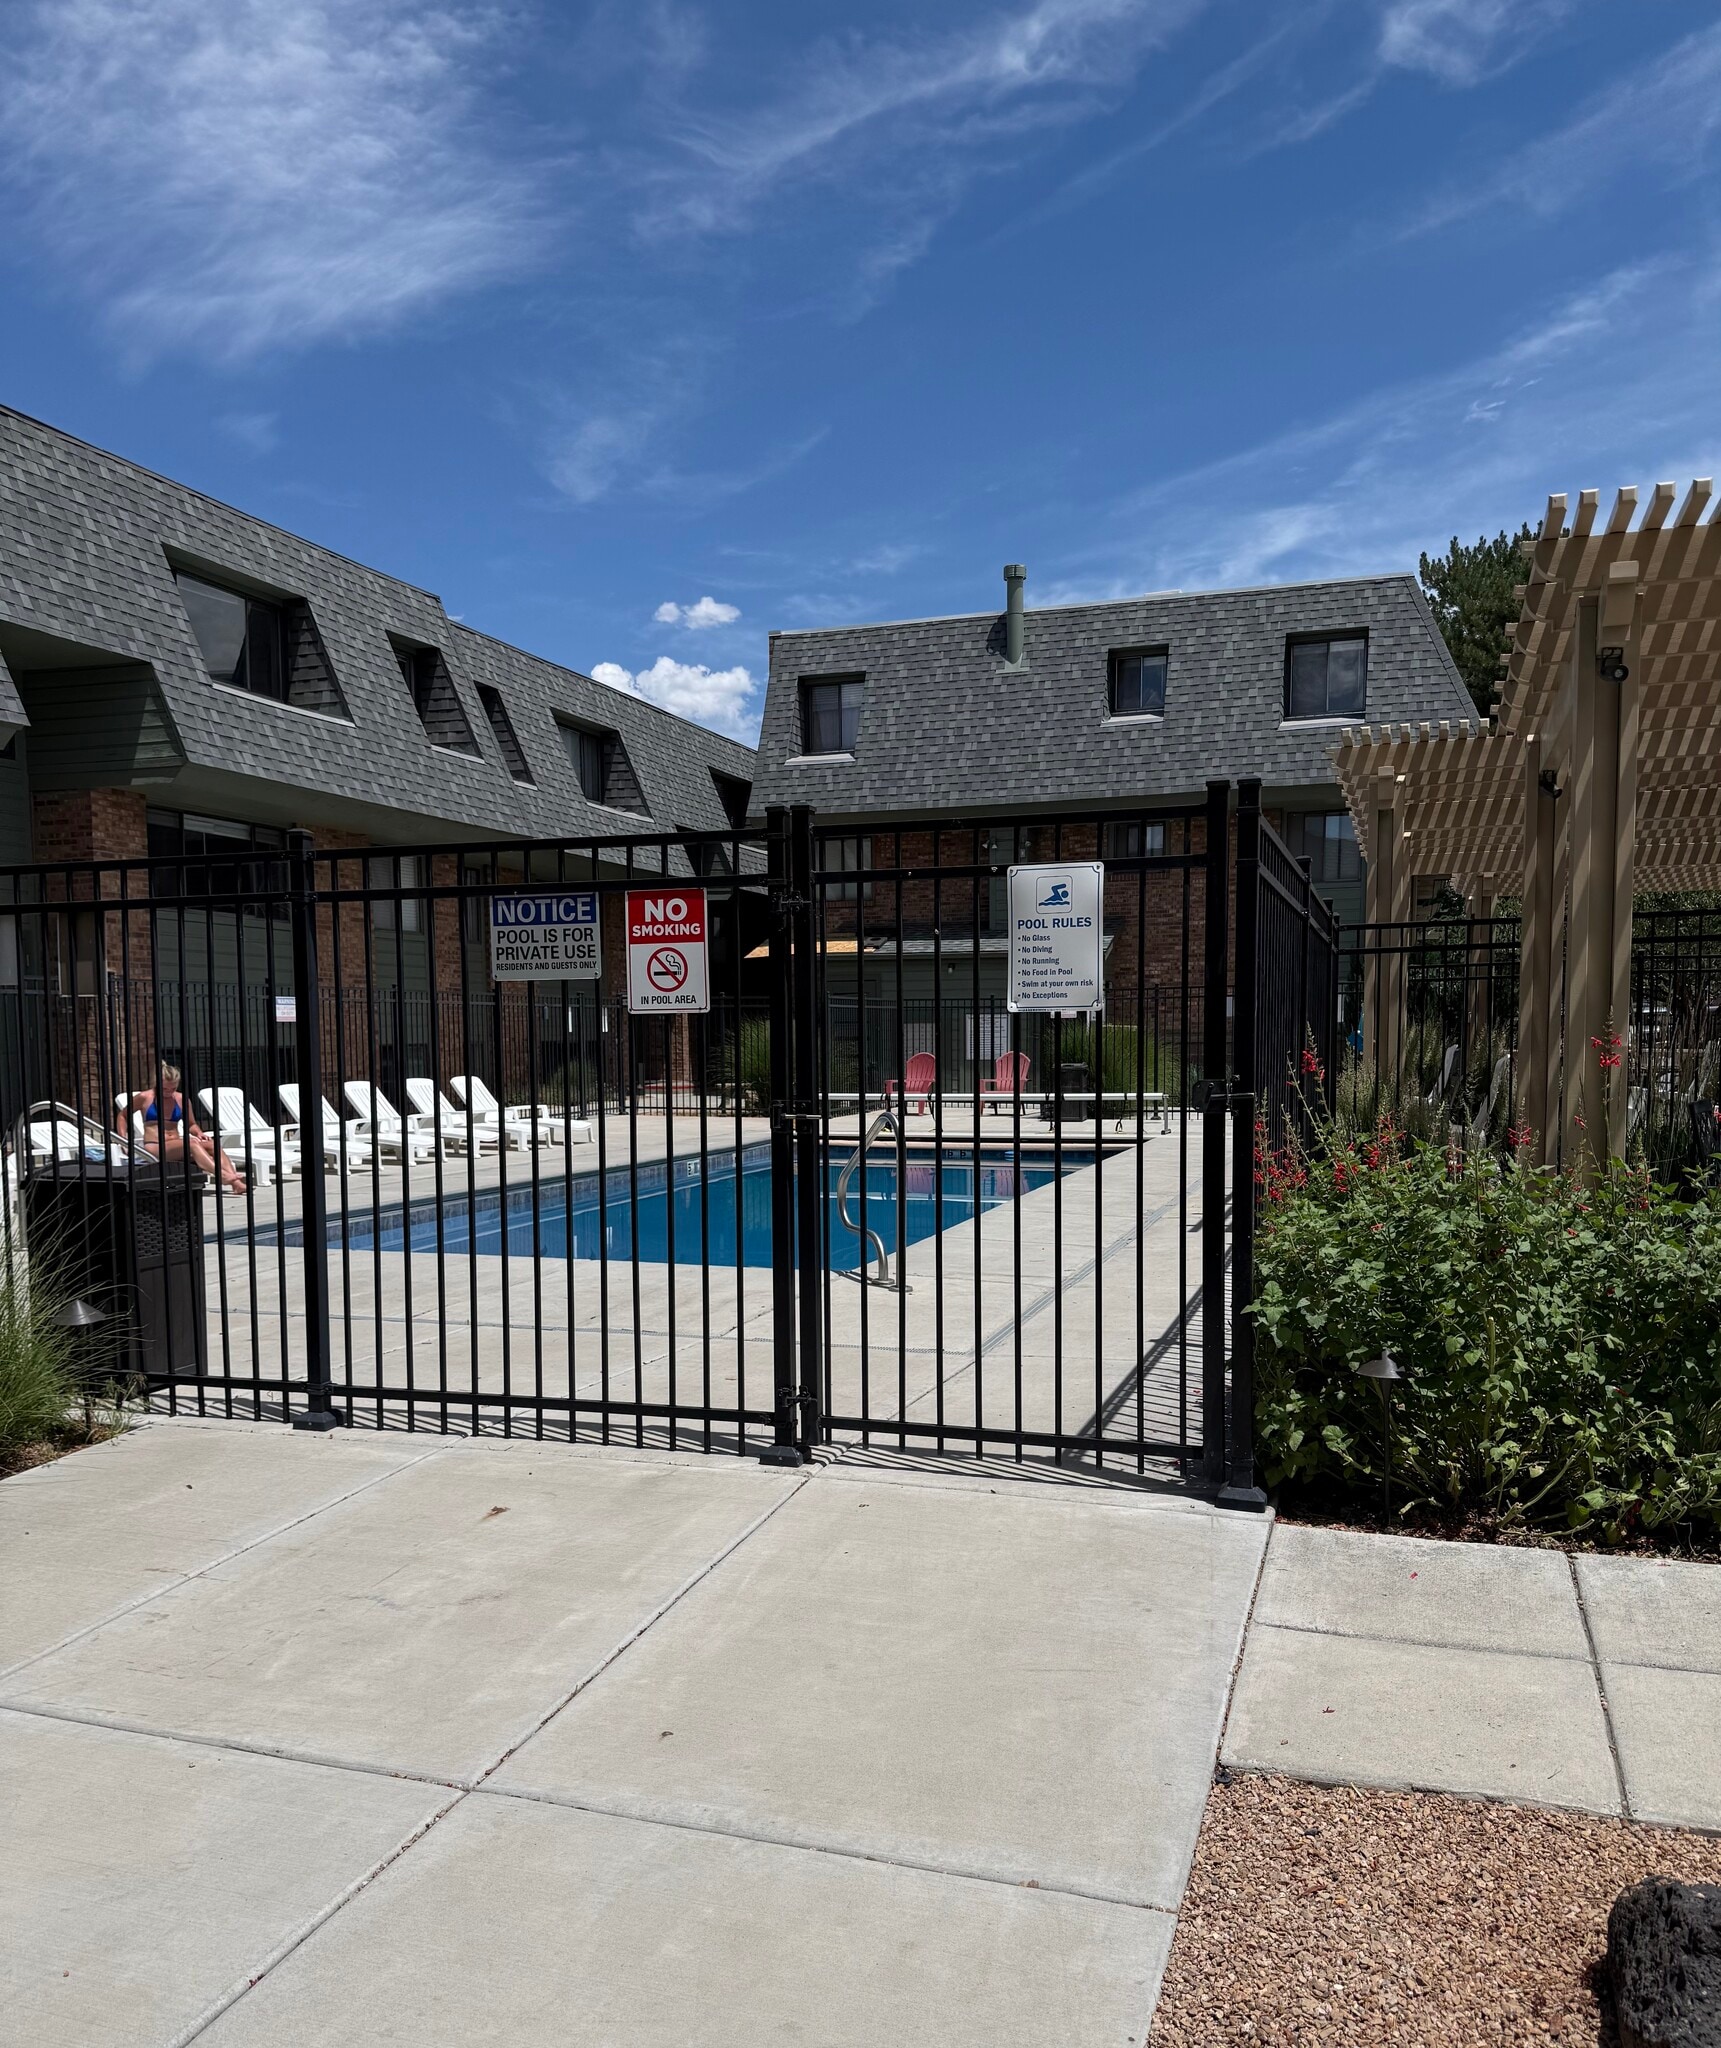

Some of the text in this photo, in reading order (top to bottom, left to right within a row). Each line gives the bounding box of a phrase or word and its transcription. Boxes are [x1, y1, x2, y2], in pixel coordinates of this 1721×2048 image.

[497, 897, 593, 923] NOTICE
[644, 898, 688, 922] NO
[1017, 917, 1092, 930] POOL RULES
[632, 923, 701, 937] SMOKING
[497, 928, 594, 944] POOL IS FOR
[496, 944, 597, 961] PRIVATE USE
[1032, 946, 1053, 954] Diving
[496, 961, 597, 971] RESIDENTS AND GUESTS ONLY
[1032, 957, 1060, 965] Running
[1048, 980, 1063, 989] your
[641, 995, 697, 1005] IN POOL AREA
[1032, 991, 1068, 999] Exceptions
